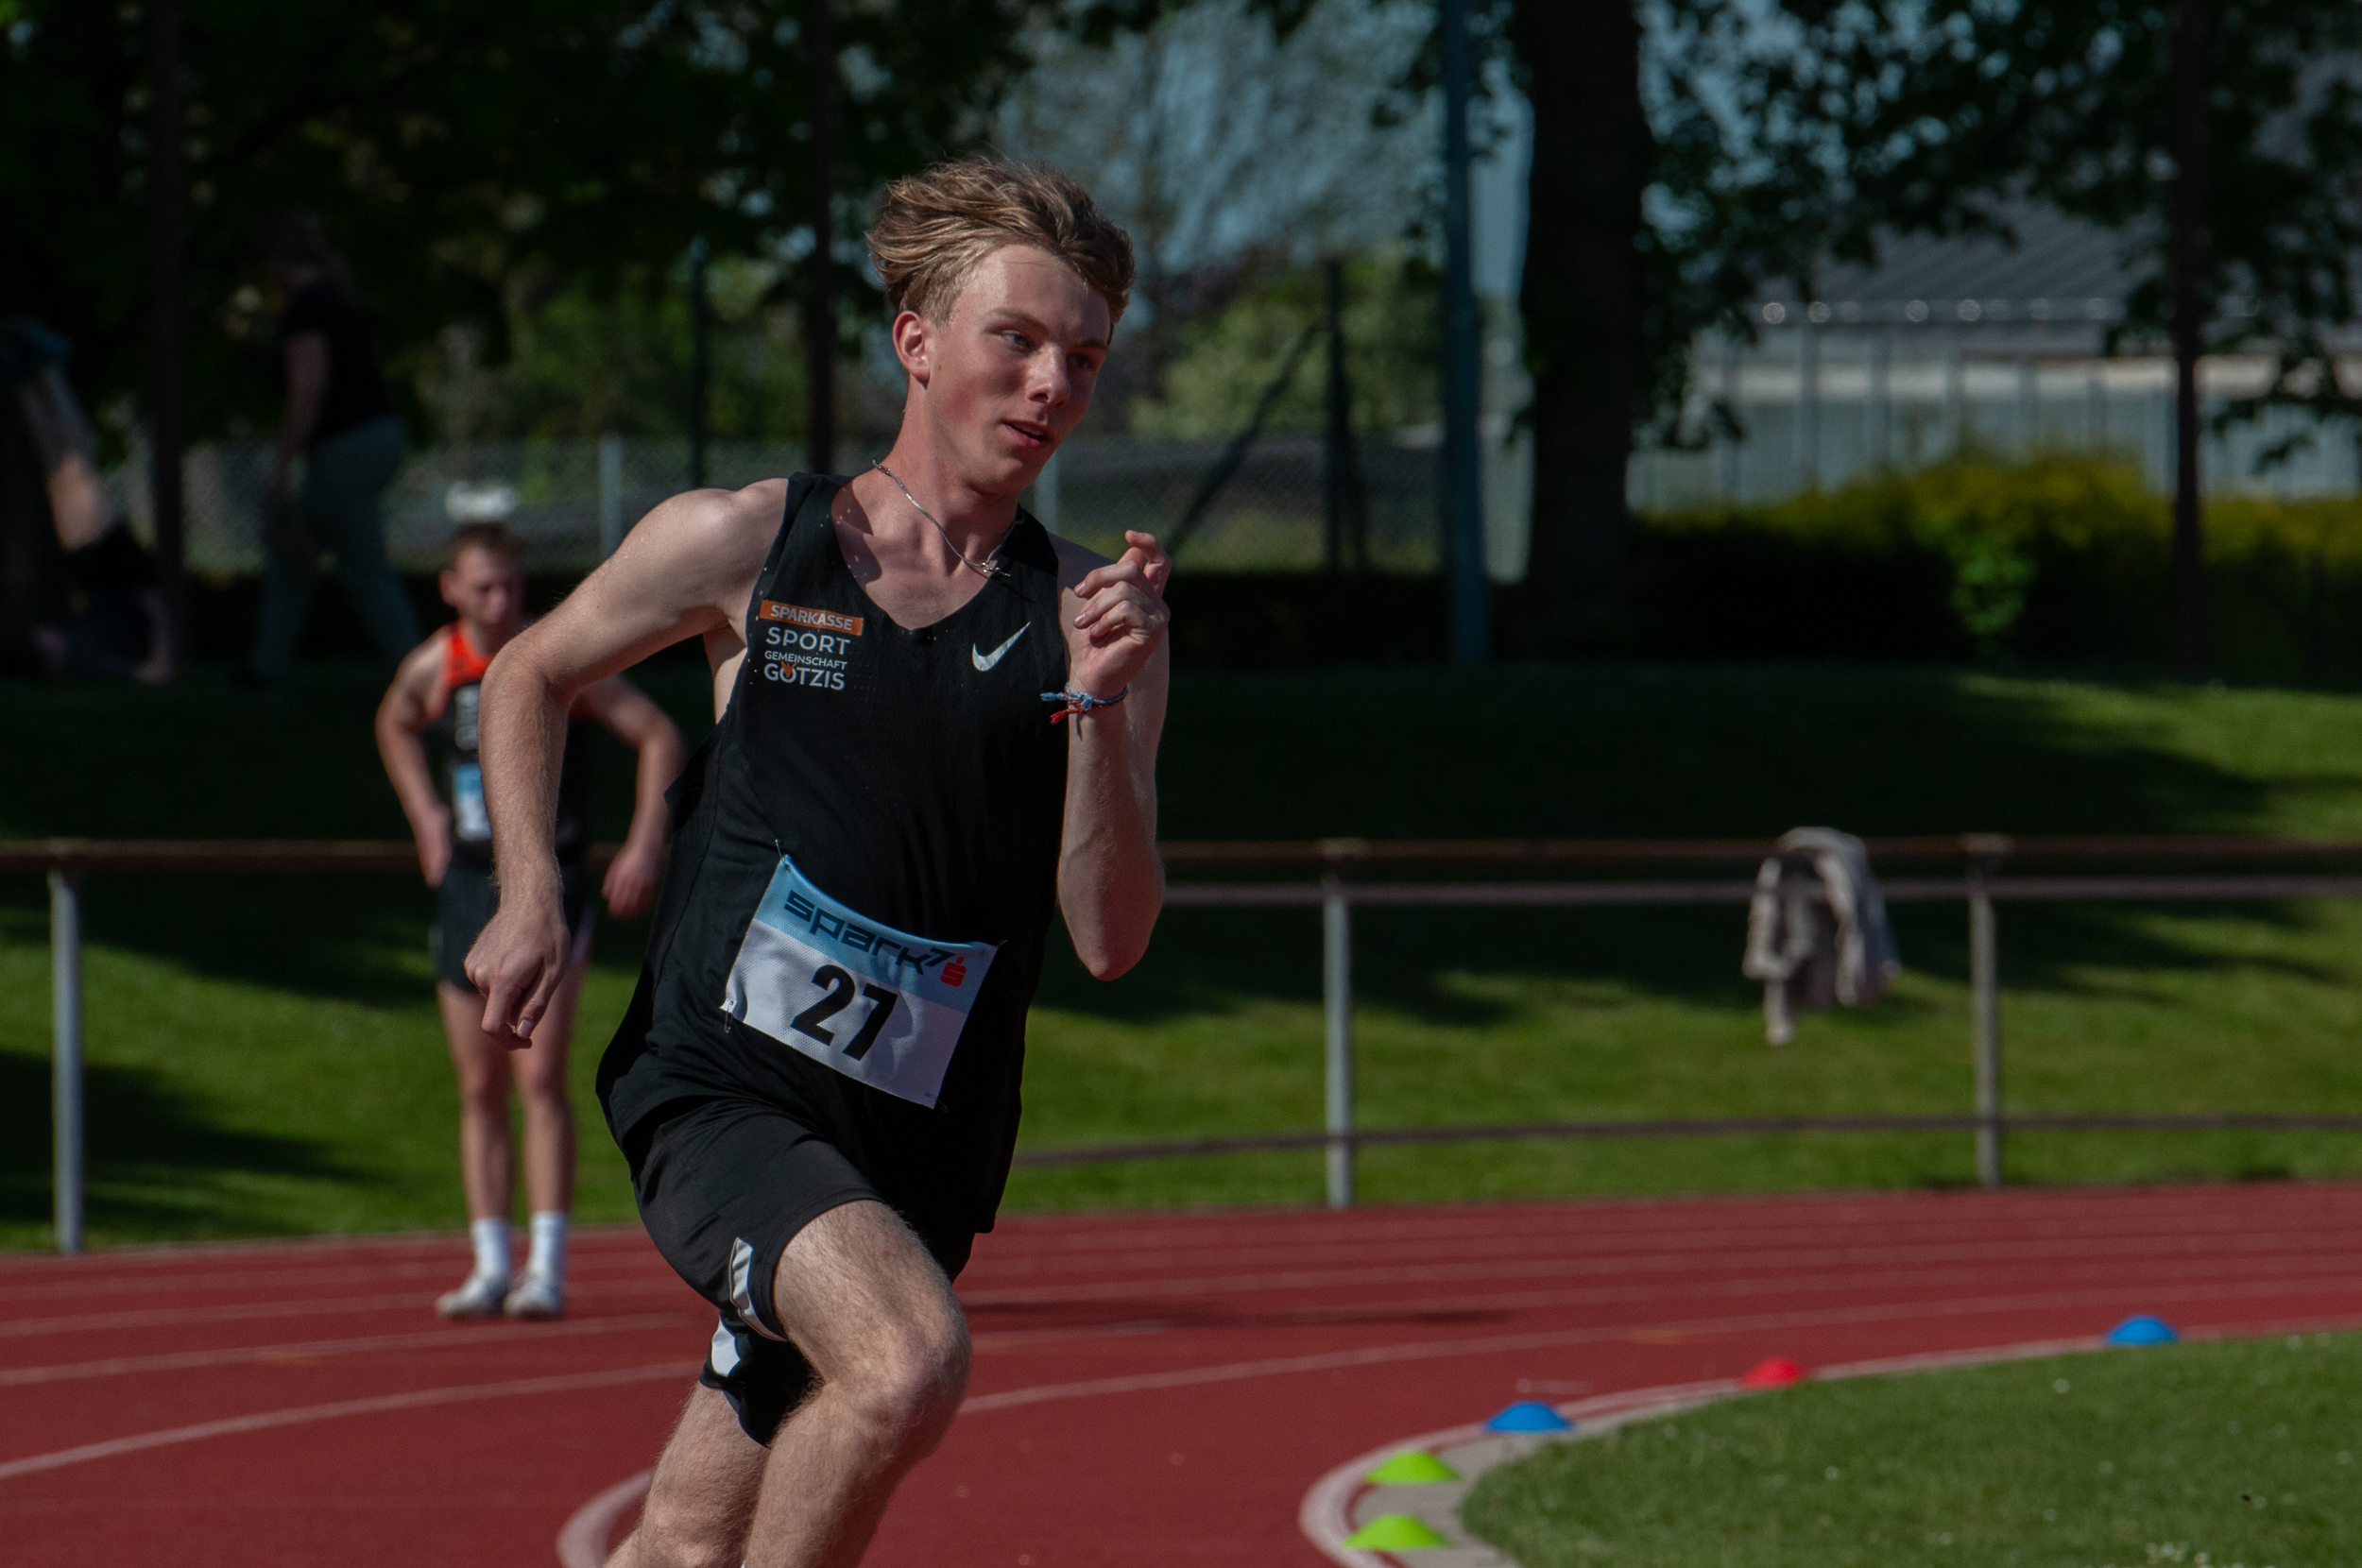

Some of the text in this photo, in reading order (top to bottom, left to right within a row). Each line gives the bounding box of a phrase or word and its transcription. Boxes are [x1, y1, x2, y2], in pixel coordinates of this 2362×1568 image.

[771, 605, 853, 631] SPARKASSE
[766, 628, 850, 655] SPORT
[765, 651, 847, 671] GEMEINSCHAFT
[791, 965, 899, 1061] 27
